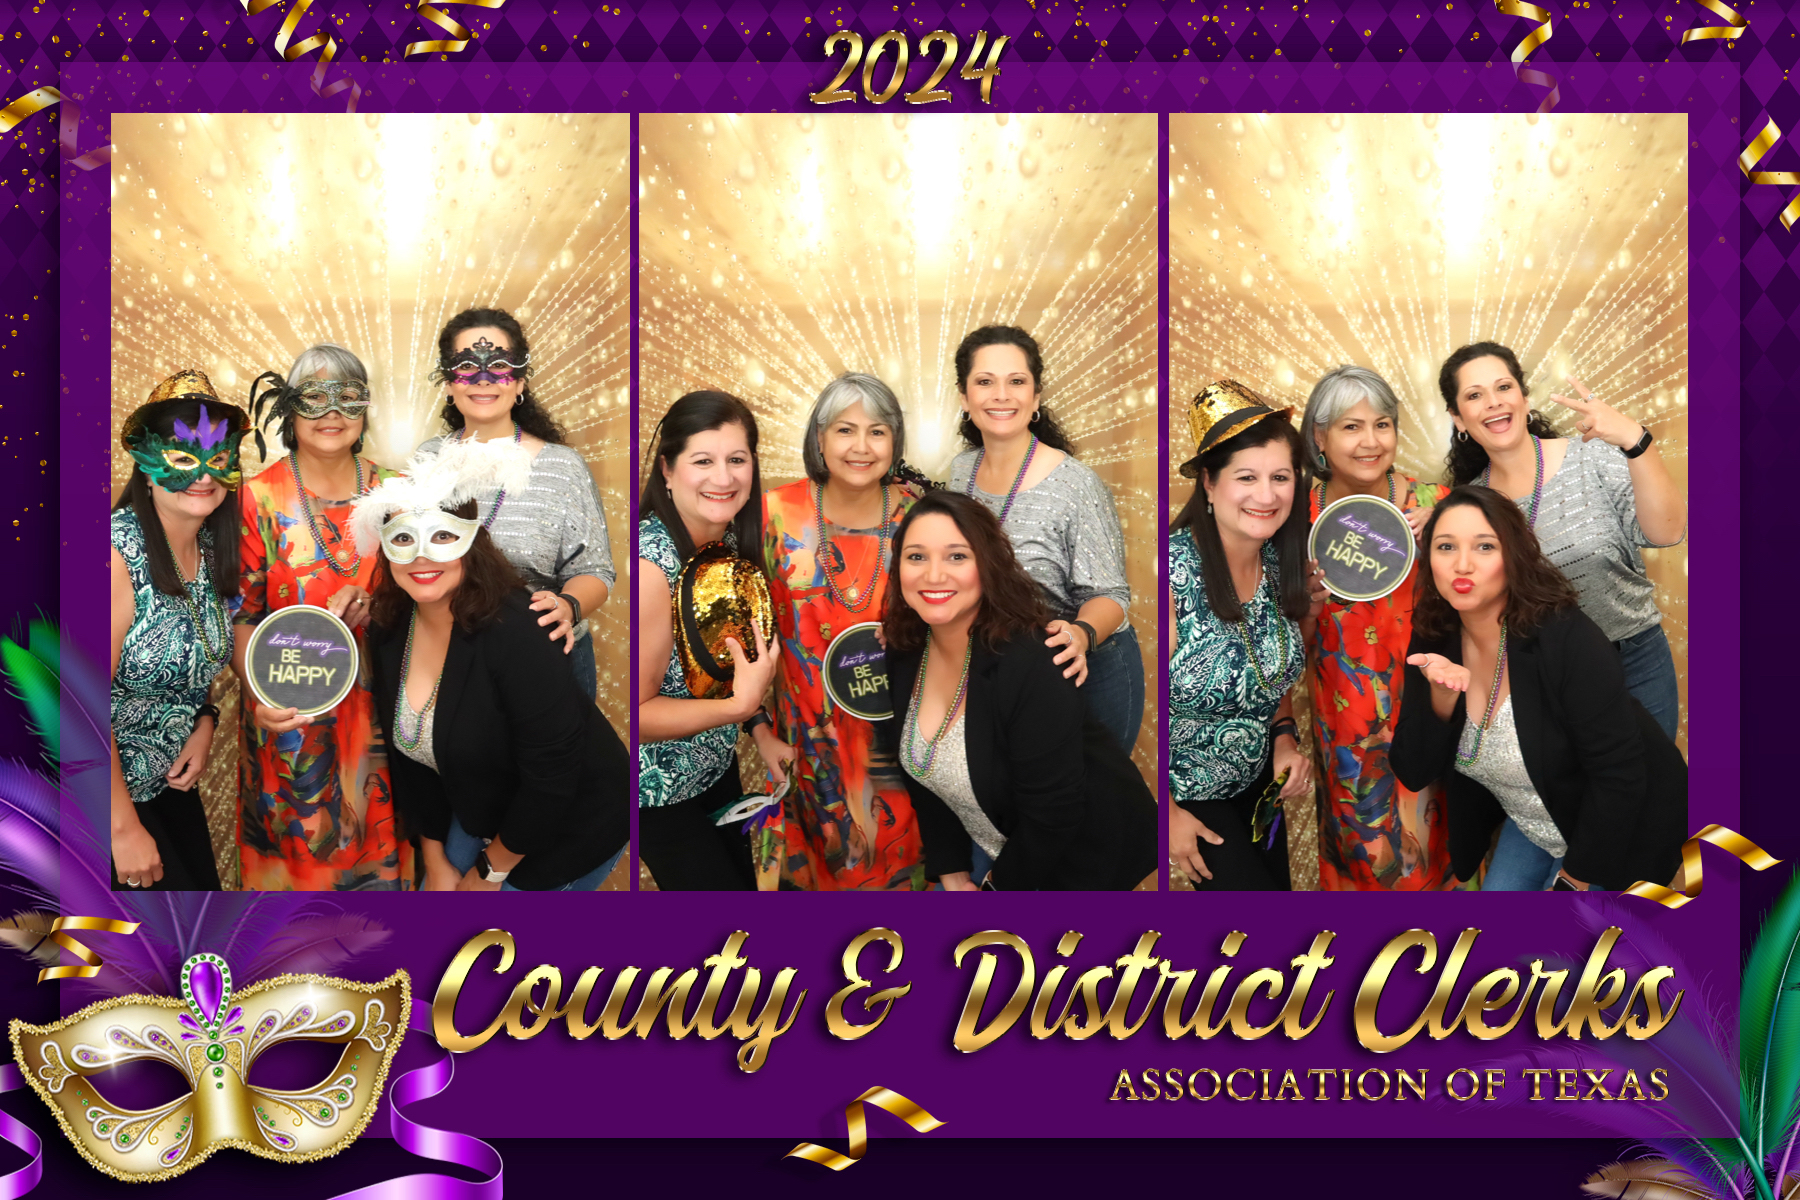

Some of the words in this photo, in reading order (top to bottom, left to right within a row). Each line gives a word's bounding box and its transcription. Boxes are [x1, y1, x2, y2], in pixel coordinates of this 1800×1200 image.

[1343, 531, 1364, 550] BE
[1368, 532, 1406, 557] worry
[1325, 539, 1389, 580] HAPPY
[281, 648, 301, 663] BE
[302, 642, 348, 655] worry
[868, 652, 885, 661] wor
[268, 663, 336, 686] HAPPY
[853, 664, 873, 678] BE
[848, 674, 889, 698] HAPP
